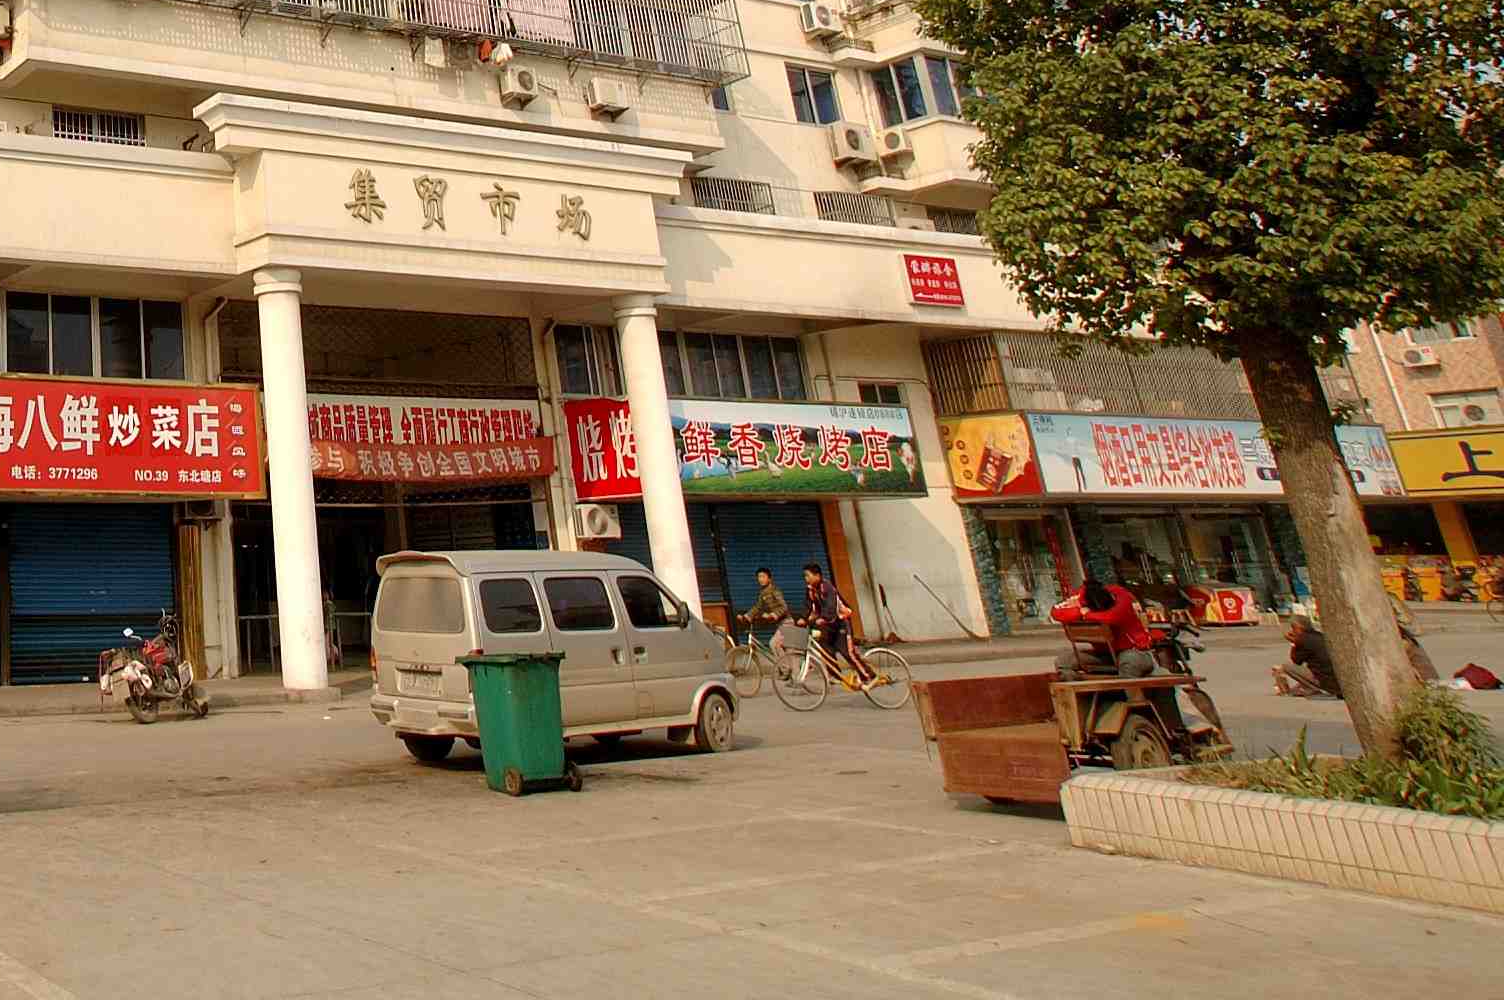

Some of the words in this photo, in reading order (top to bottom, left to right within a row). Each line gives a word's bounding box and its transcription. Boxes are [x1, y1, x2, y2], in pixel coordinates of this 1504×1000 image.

[344, 167, 593, 242] 集贸市场
[357, 445, 542, 478] 积极争创全国文明城市
[577, 408, 641, 483] 烧烤
[680, 419, 892, 472] 鲜香烧烤店
[134, 469, 169, 482] NO.39
